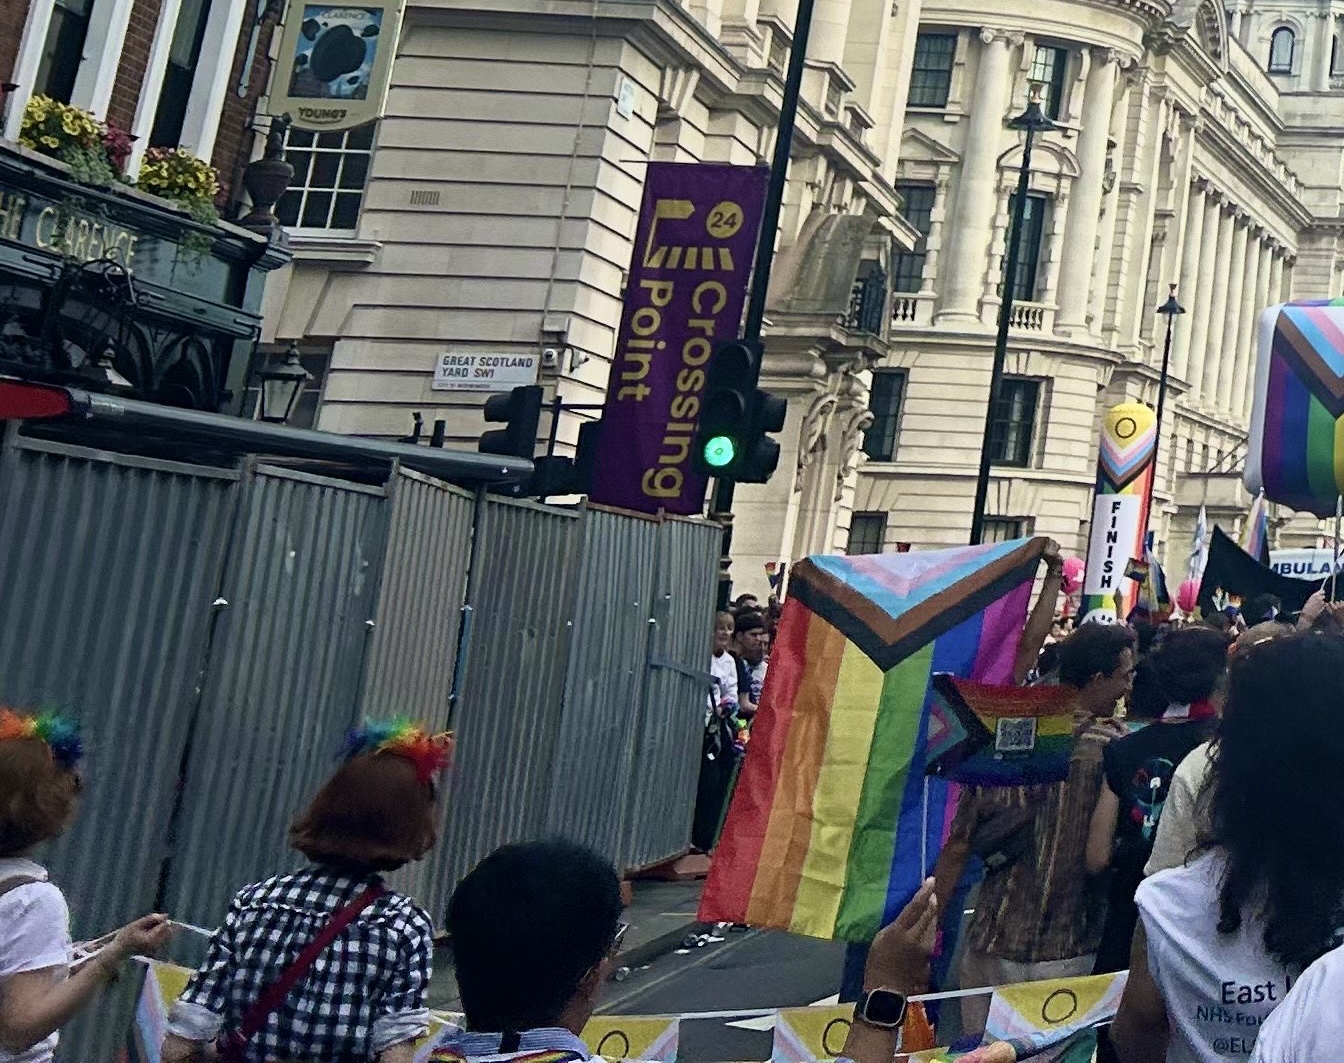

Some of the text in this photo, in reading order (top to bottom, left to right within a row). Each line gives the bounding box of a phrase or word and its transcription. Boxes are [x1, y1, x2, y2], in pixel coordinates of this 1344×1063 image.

[0, 190, 27, 240] HE
[710, 211, 738, 230] 24
[617, 279, 674, 403] Point
[442, 355, 533, 368] GREAT SCOTLAND
[442, 368, 495, 378] YARD SW1
[641, 280, 728, 498] Crossing
[1100, 500, 1122, 589] FINISH
[1221, 980, 1278, 1005] East
[1196, 1004, 1232, 1024] NHS
